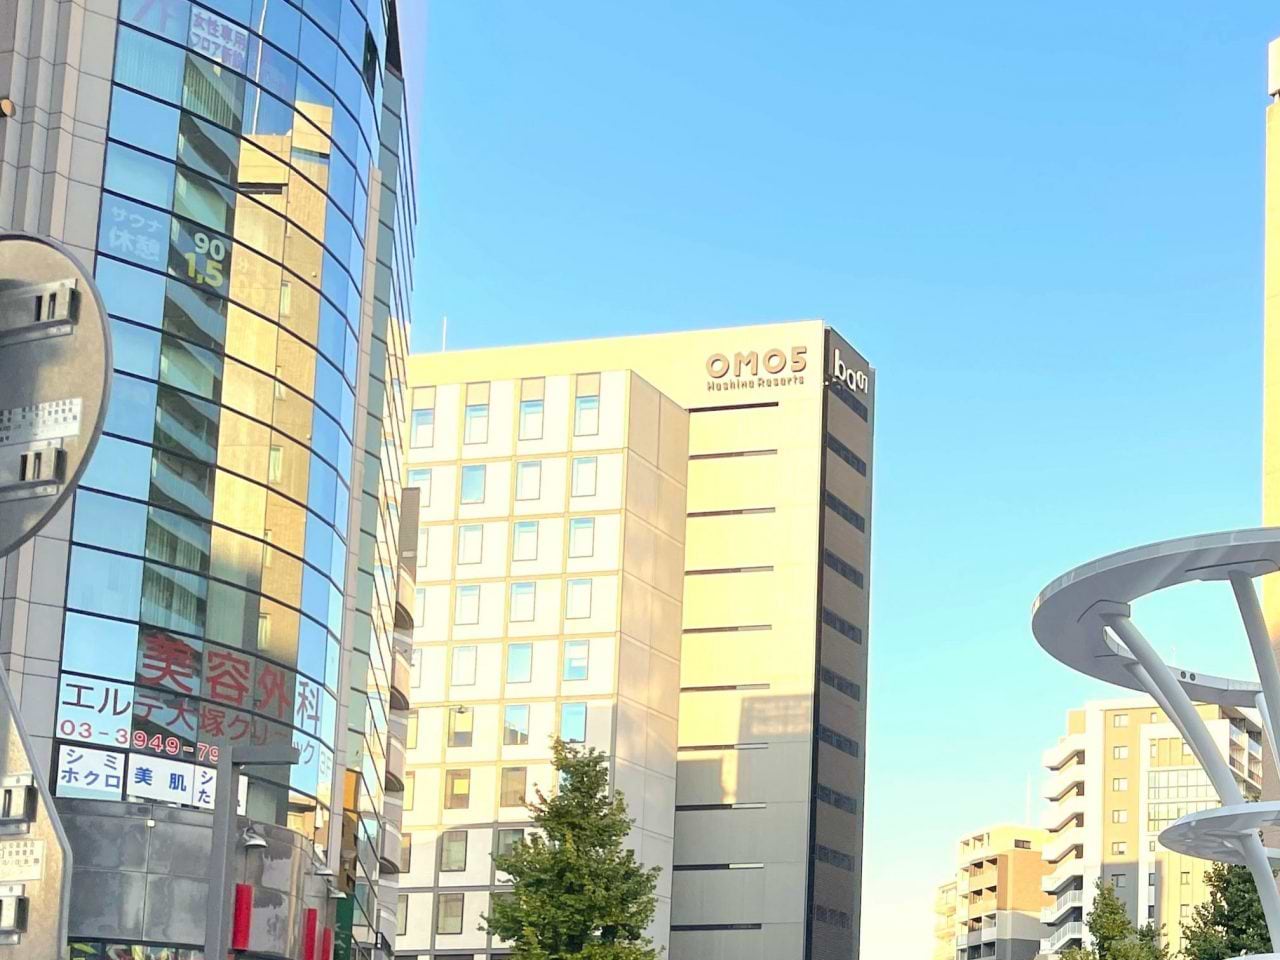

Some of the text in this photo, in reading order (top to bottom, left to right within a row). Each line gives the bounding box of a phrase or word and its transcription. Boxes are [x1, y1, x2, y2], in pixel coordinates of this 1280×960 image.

[706, 346, 808, 379] OMO5
[707, 374, 805, 392] Hoshino Resorts
[141, 632, 321, 736] 美容外科
[60, 766, 121, 790] ホクロ
[133, 766, 187, 792] 美肌
